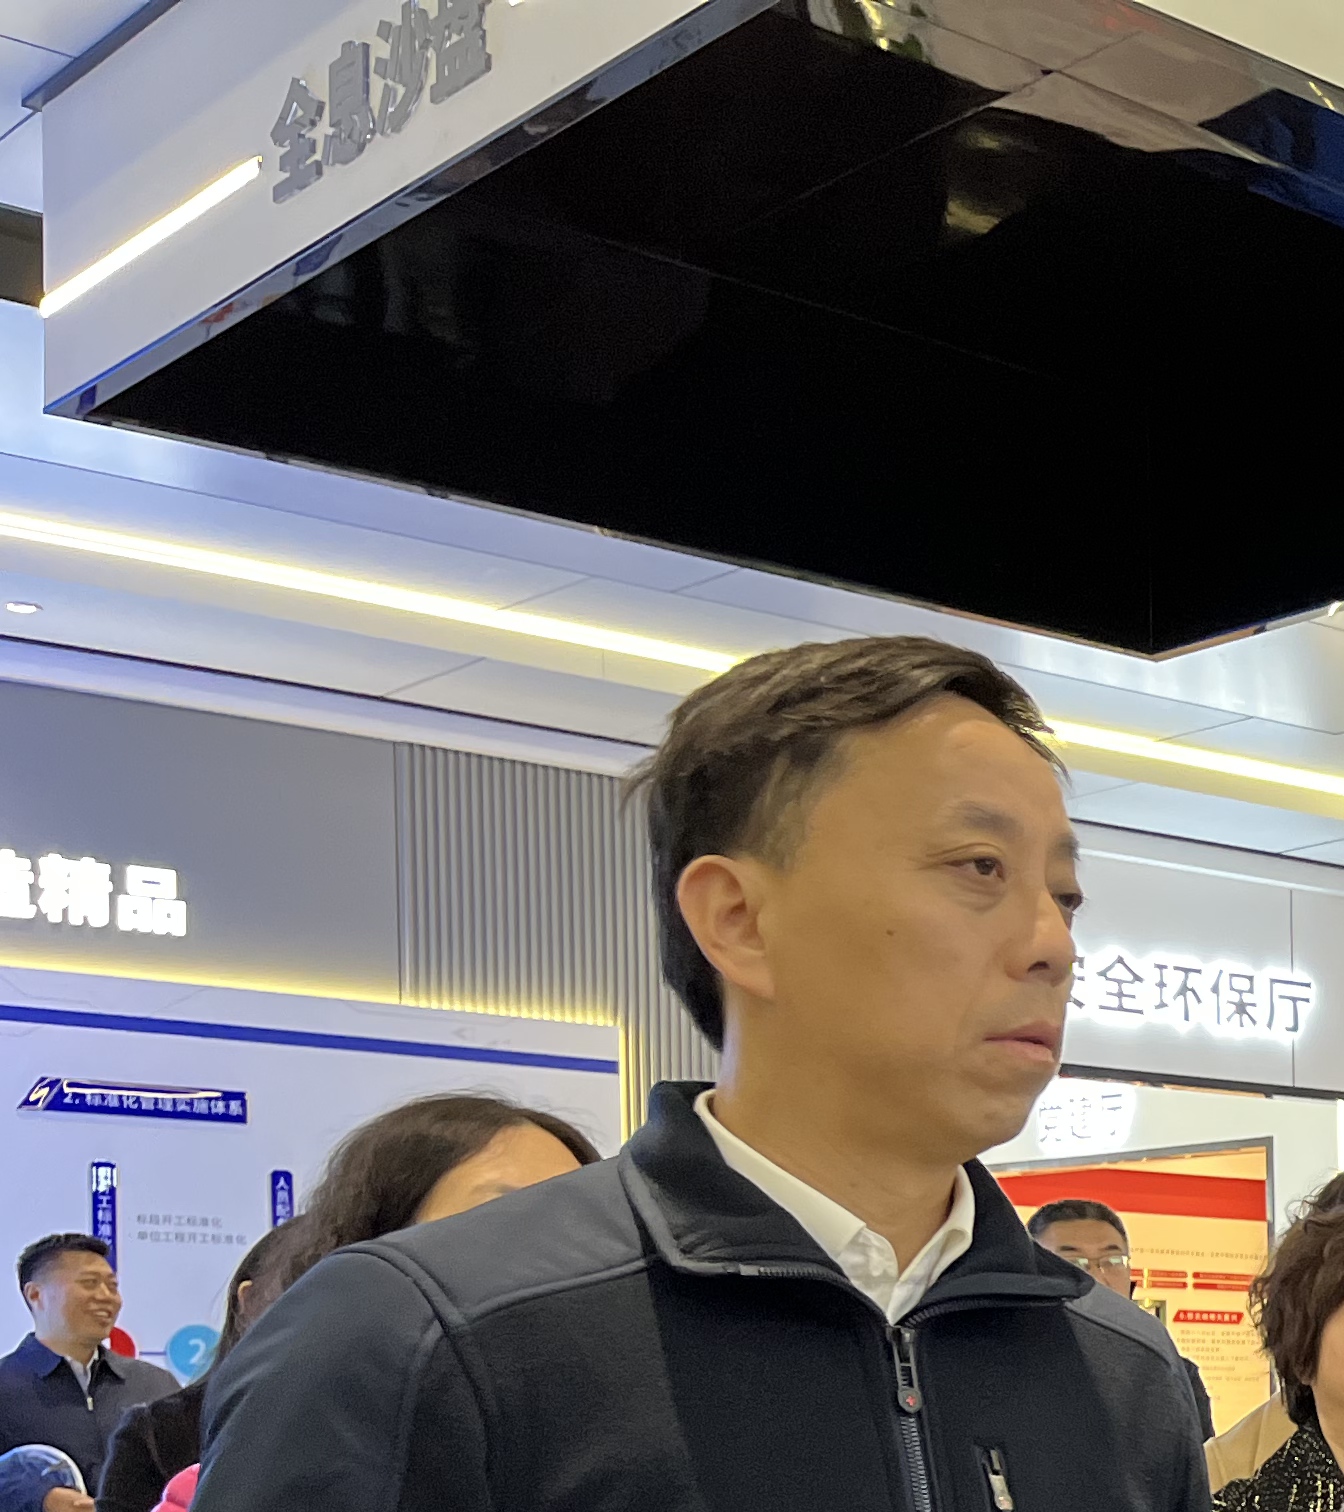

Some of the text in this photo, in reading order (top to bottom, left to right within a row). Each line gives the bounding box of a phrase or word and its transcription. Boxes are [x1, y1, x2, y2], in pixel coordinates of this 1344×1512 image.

[270, 0, 492, 204] 全息沙盘
[1071, 954, 1312, 1033] 全环保厅
